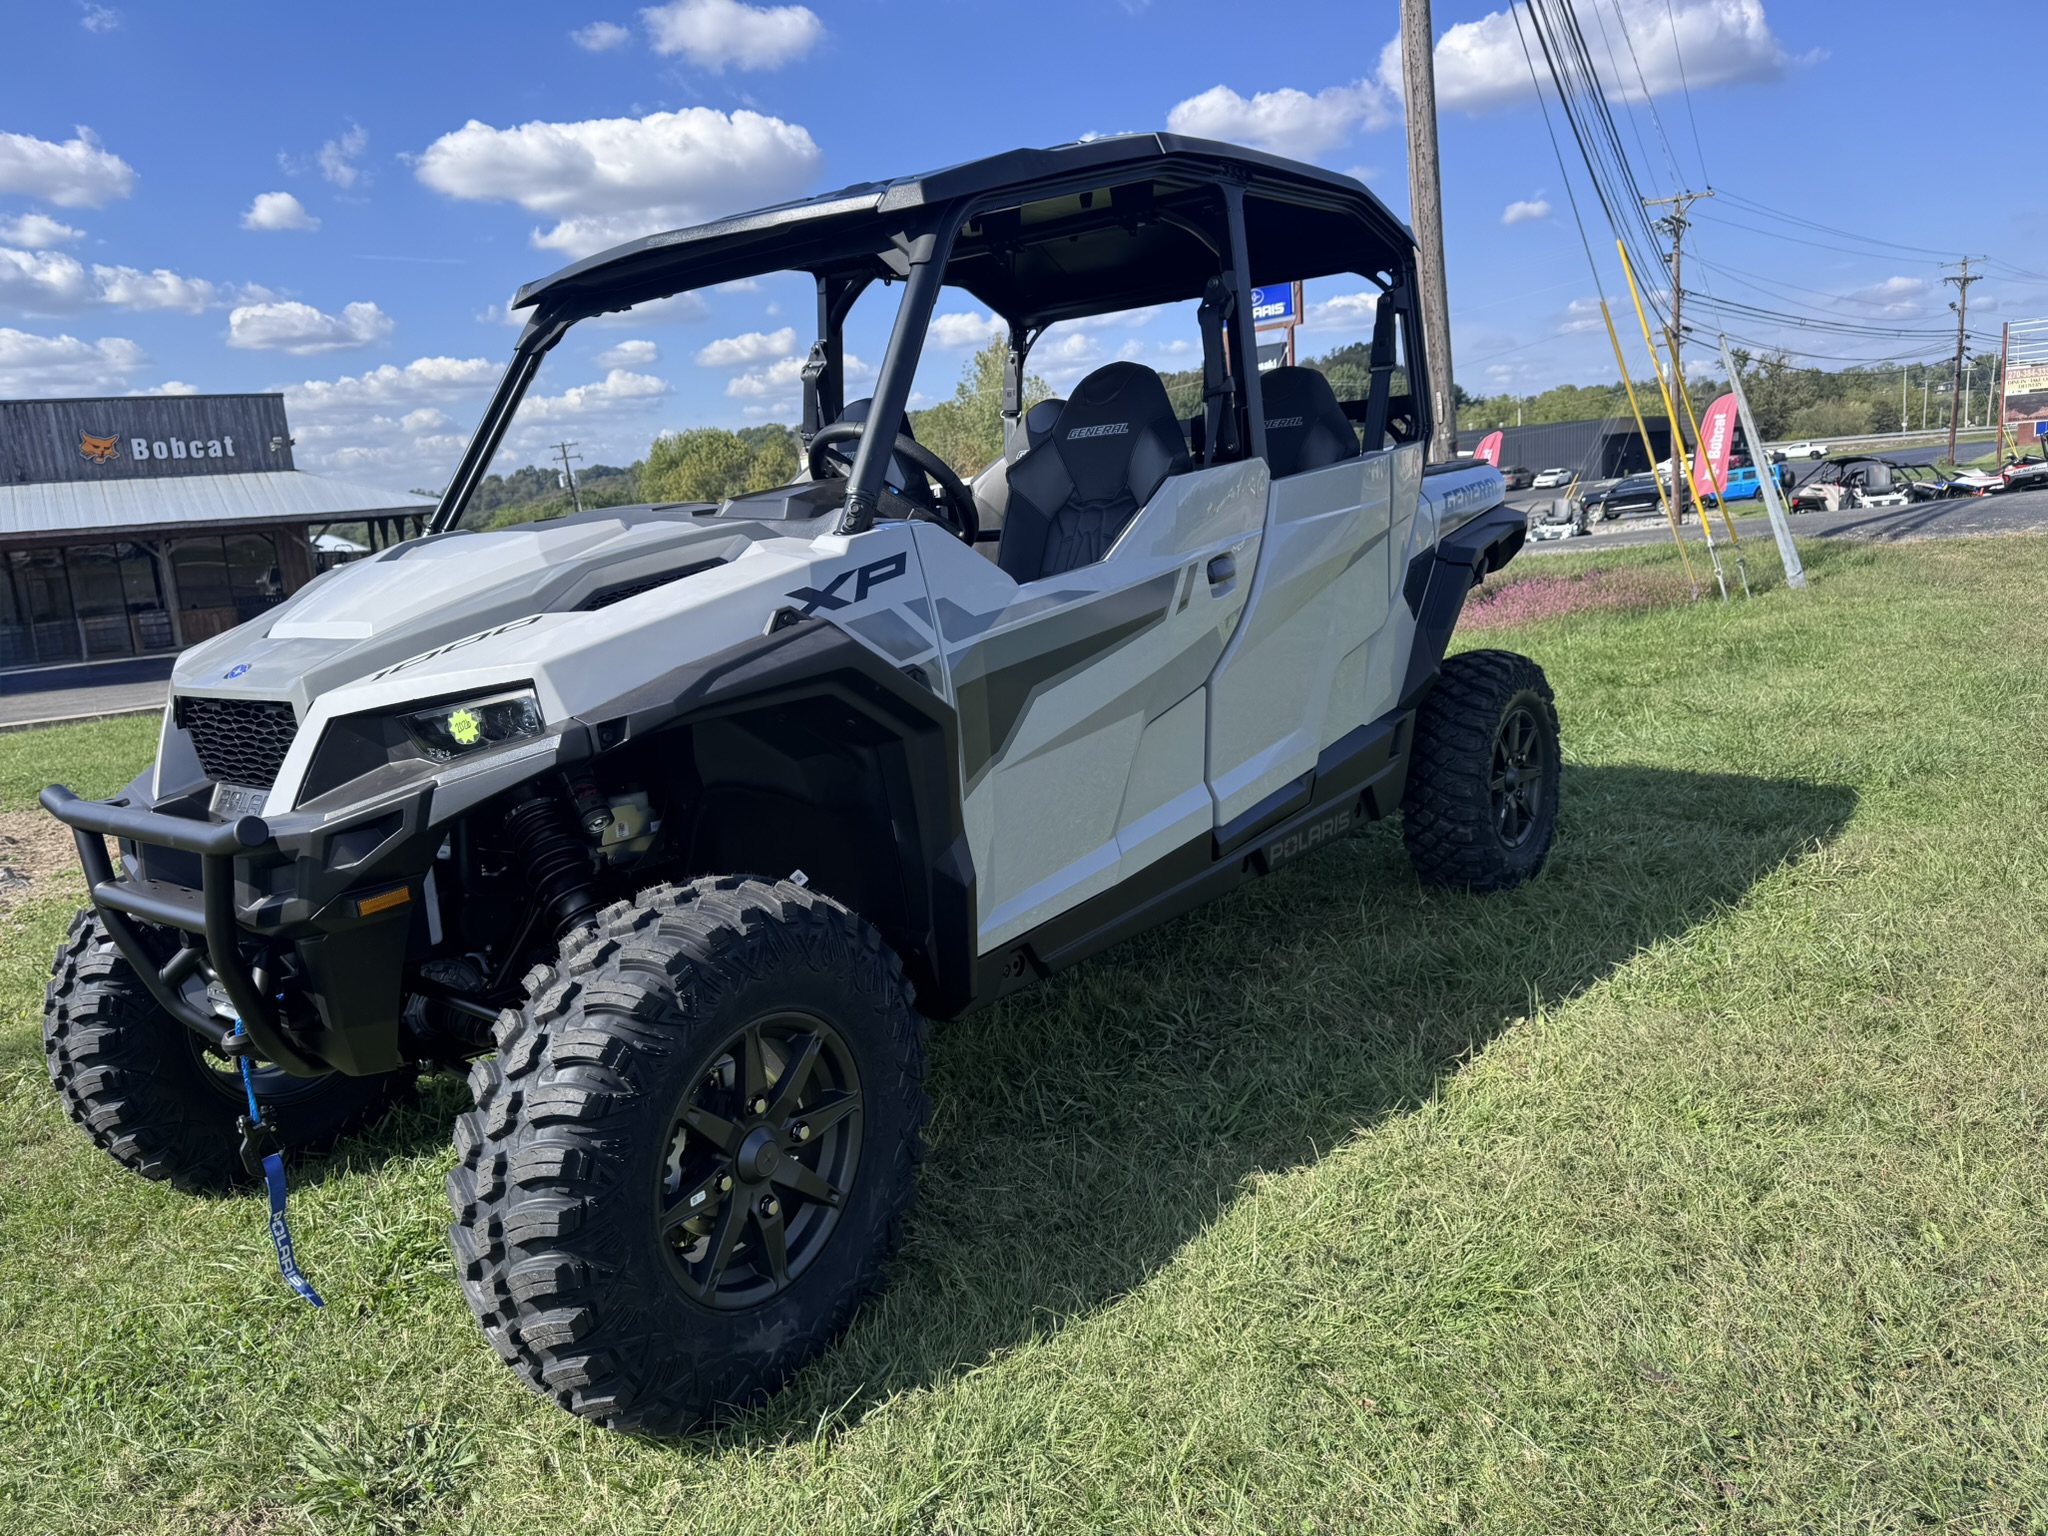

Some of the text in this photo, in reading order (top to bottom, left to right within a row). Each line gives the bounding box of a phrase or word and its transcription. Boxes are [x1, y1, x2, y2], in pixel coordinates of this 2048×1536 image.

[1253, 302, 1286, 319] ARIS
[2007, 367, 2048, 379] 270-384-333
[1067, 423, 1129, 440] GENERAL
[1264, 416, 1303, 429] NERAL
[1707, 413, 1727, 459] Bobcat
[130, 436, 235, 460] Bobcat
[1442, 477, 1500, 514] GENERAL
[784, 551, 907, 617] XP
[371, 615, 543, 682] 1000
[455, 719, 471, 733] 2026
[217, 789, 269, 816] POLA
[1270, 810, 1351, 866] POLARIS
[272, 1210, 305, 1287] POLARIS
